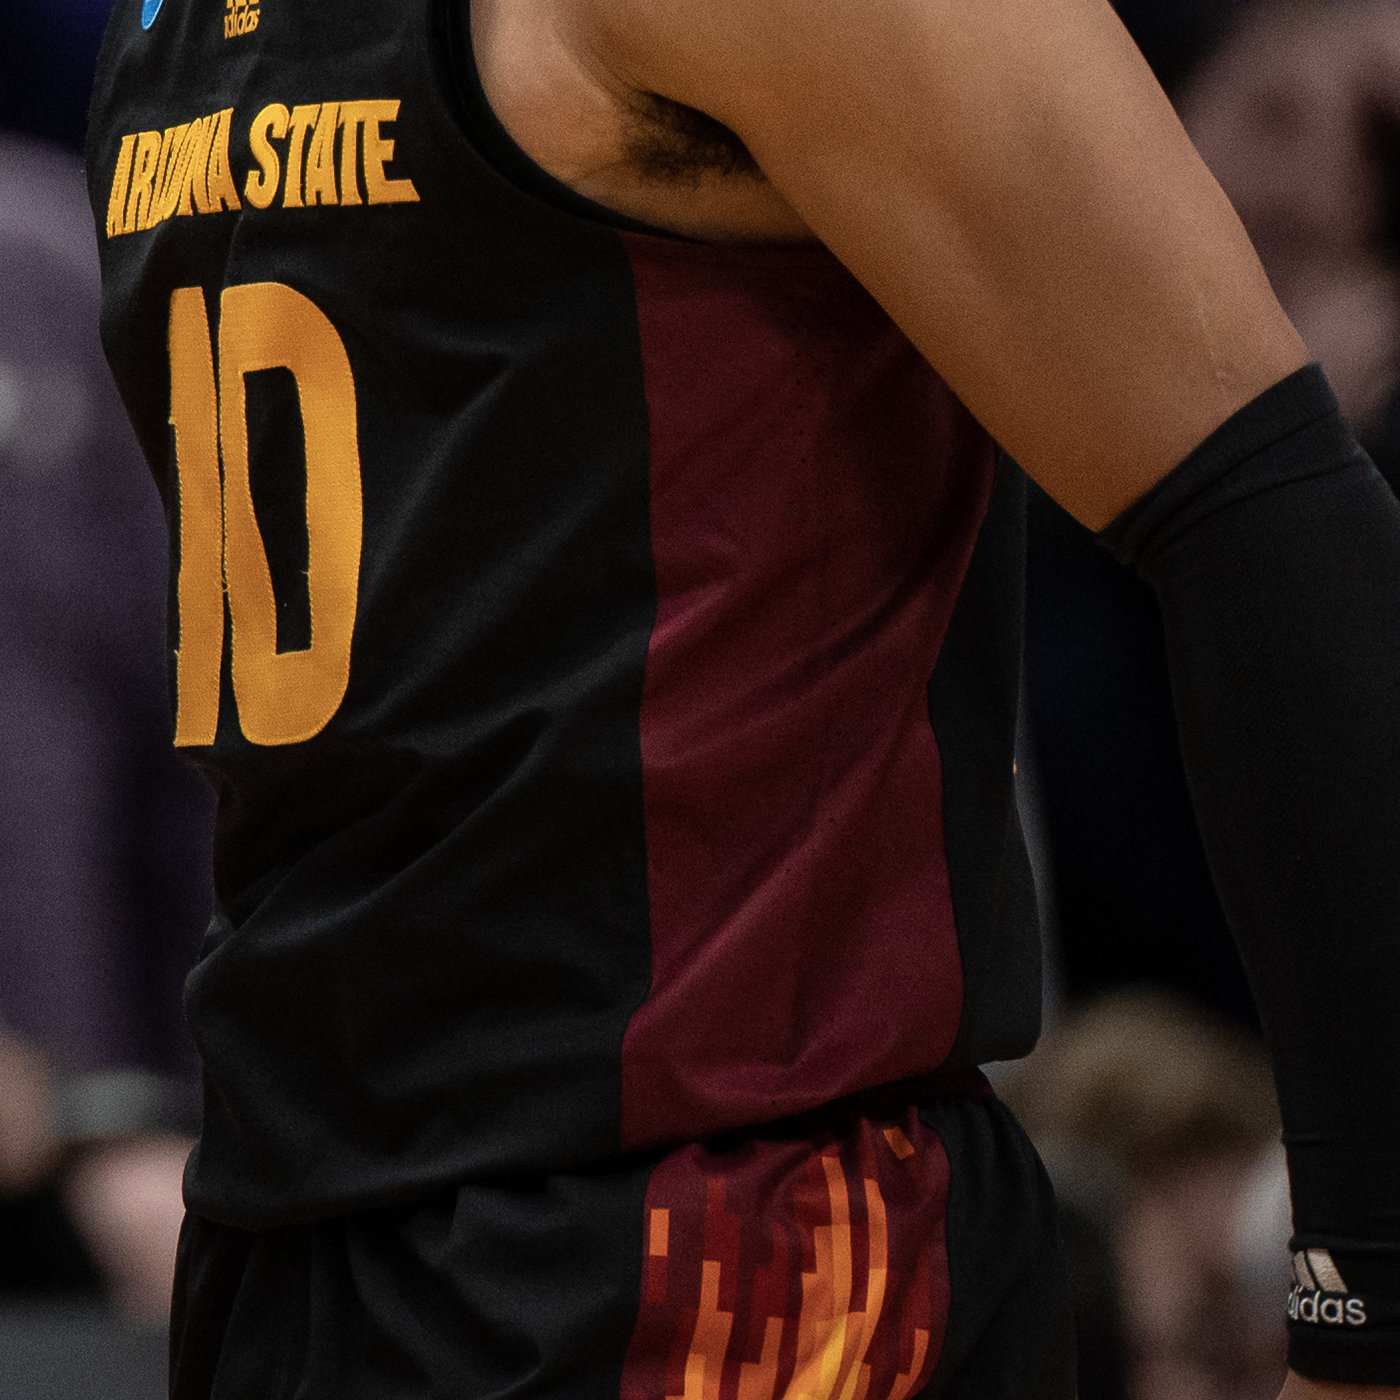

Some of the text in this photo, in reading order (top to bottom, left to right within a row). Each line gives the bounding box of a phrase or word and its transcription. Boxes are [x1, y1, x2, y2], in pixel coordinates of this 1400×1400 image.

[106, 100, 421, 240] ARIZONA STATE
[168, 282, 363, 747] 10
